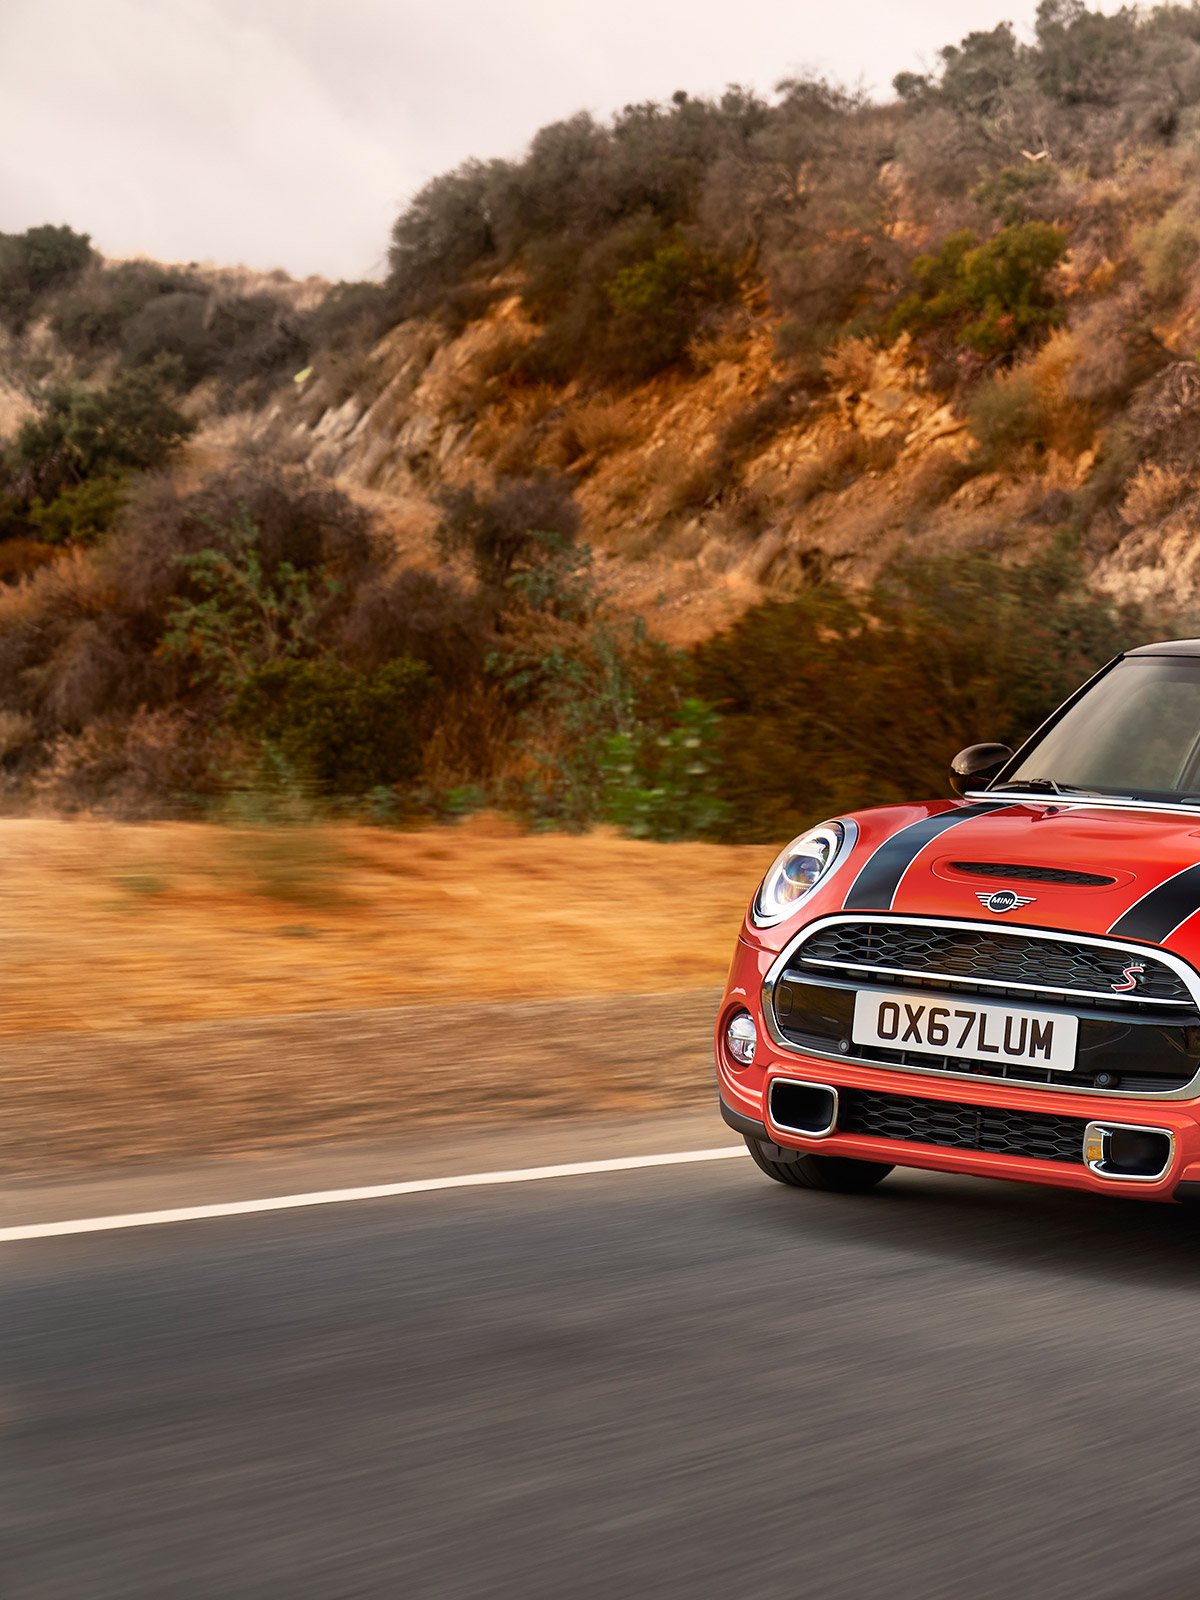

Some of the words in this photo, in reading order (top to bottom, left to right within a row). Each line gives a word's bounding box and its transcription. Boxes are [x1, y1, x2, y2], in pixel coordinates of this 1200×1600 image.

[991, 896, 1014, 905] MINI
[1111, 966, 1144, 993] S
[877, 1001, 1054, 1060] OX67LUM
